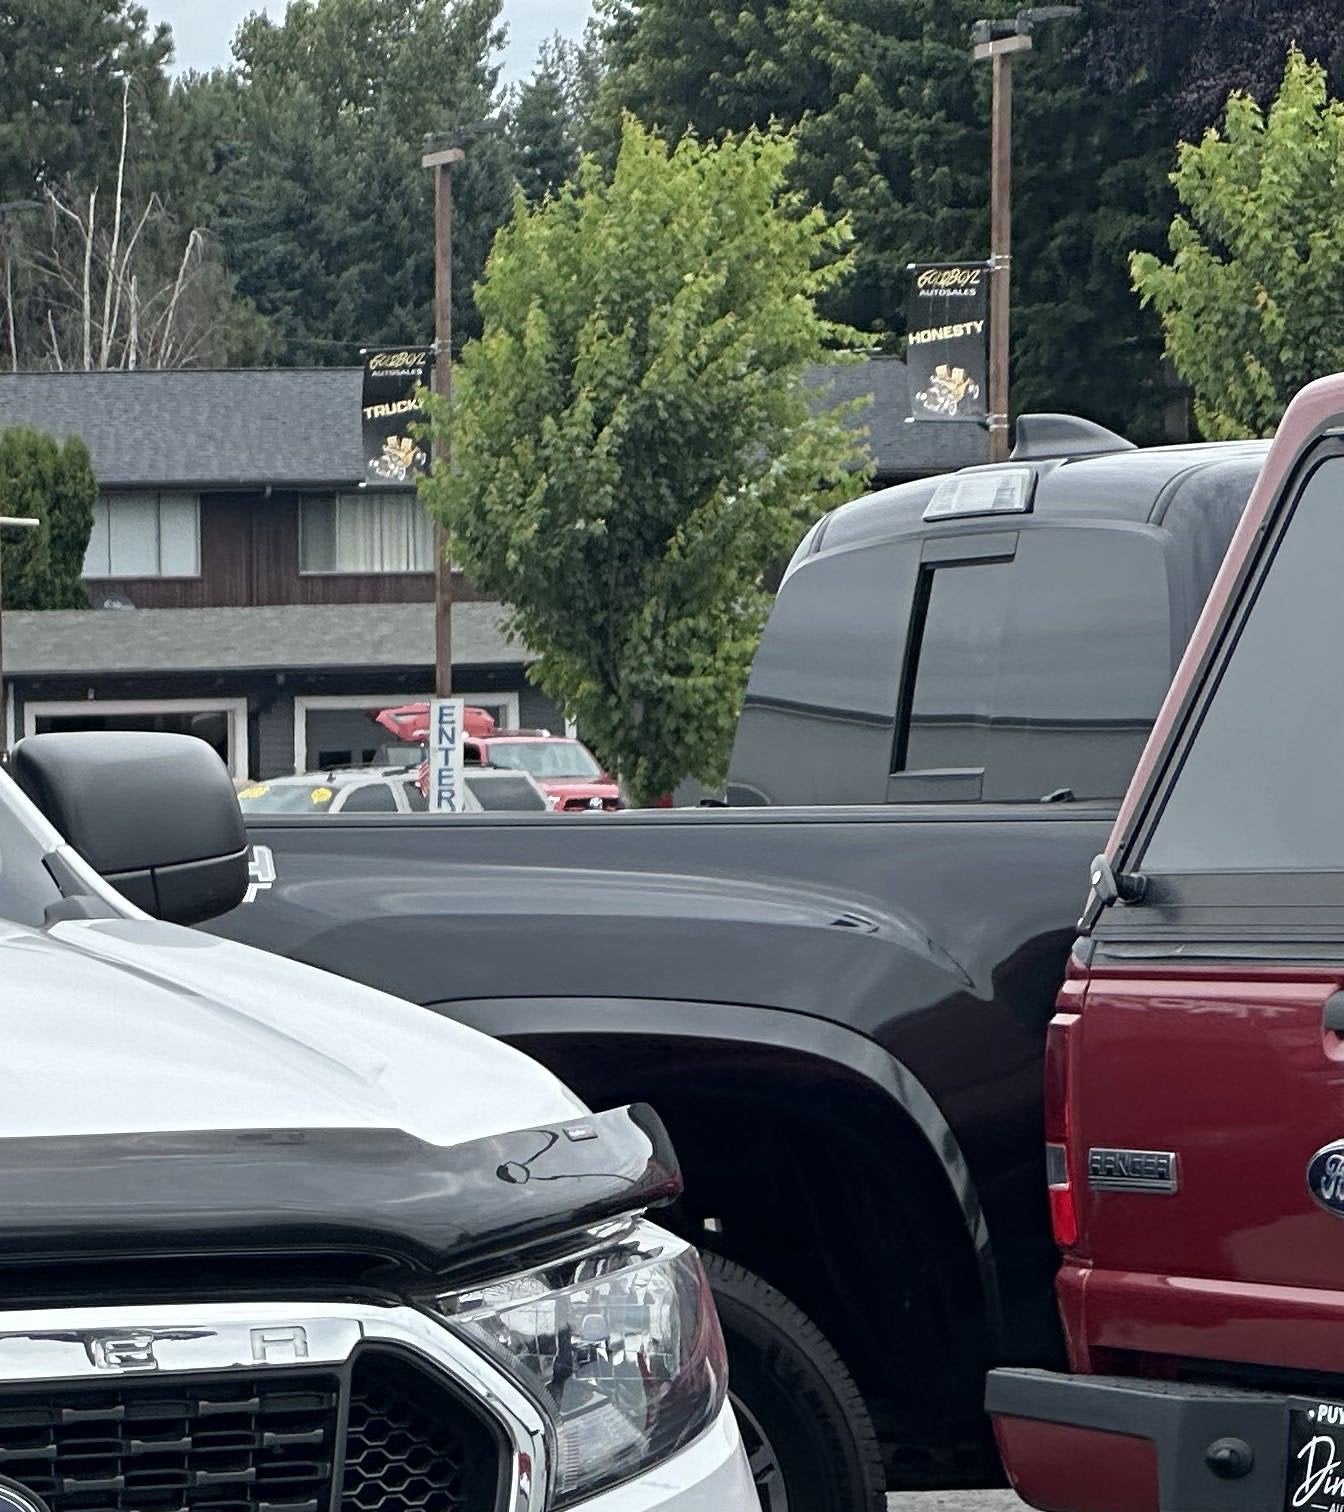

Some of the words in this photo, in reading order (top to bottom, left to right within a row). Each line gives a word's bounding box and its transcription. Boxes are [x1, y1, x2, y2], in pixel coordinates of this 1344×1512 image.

[919, 288, 977, 296] AUTOSALES
[908, 320, 985, 345] HONESTY
[372, 368, 423, 377] AUTOSALES
[437, 705, 456, 811] ENTER
[1088, 1153, 1171, 1179] RANGER
